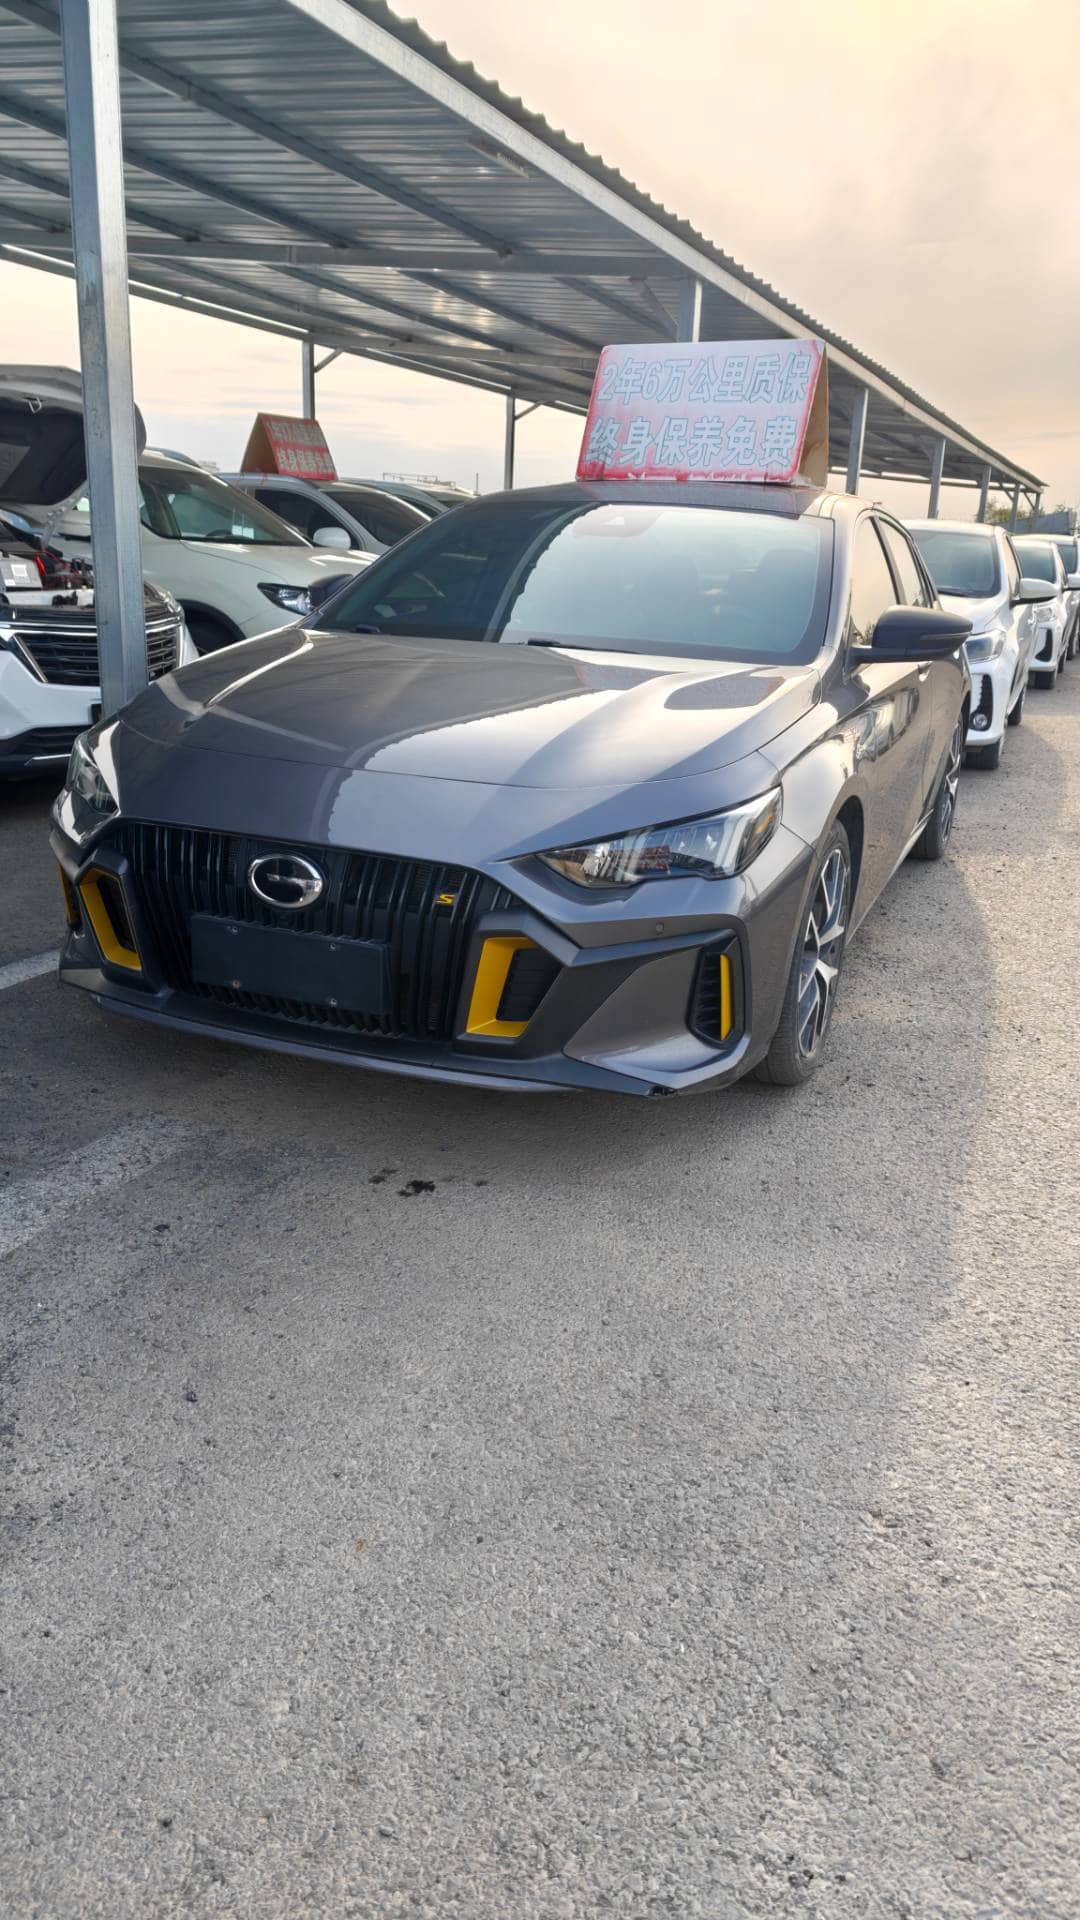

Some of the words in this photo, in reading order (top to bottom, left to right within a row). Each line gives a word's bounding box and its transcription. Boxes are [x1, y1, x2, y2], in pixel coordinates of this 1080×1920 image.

[598, 354, 811, 405] 2年6万公里质保
[586, 416, 798, 466] 终身保养免费
[435, 893, 456, 906] S
